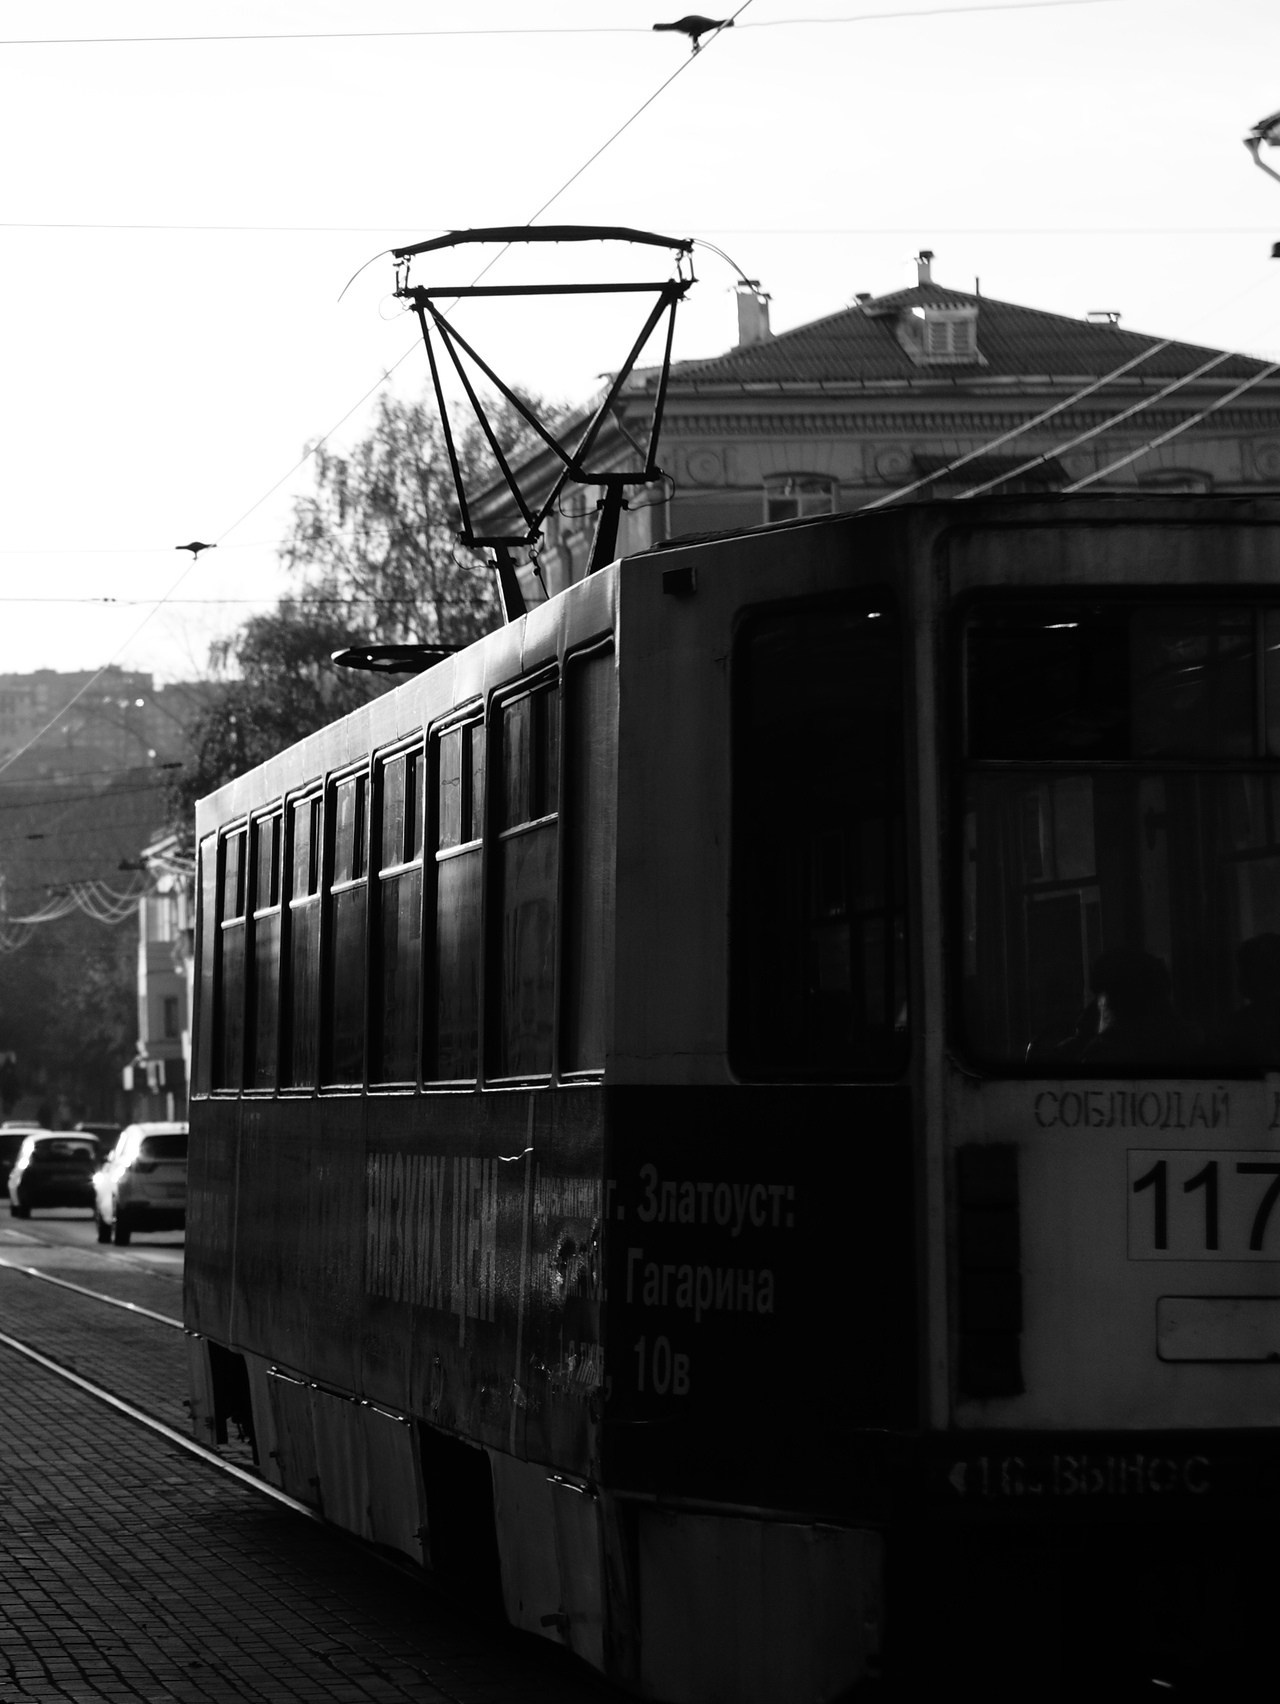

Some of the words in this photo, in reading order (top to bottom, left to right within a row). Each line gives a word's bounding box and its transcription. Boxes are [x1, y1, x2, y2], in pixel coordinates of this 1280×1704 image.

[1034, 1085, 1229, 1128] СОБЛЮДАЙ
[605, 1178, 625, 1222] г.
[637, 1162, 796, 1238] Златоуст:
[1133, 1159, 1280, 1251] 117
[365, 1151, 446, 1311] НИЗКИХ
[450, 1156, 498, 1348] ЦЕН
[626, 1247, 775, 1324] Гагарина
[633, 1335, 691, 1396] 10в
[1051, 1454, 1212, 1496] ВЫНОС
